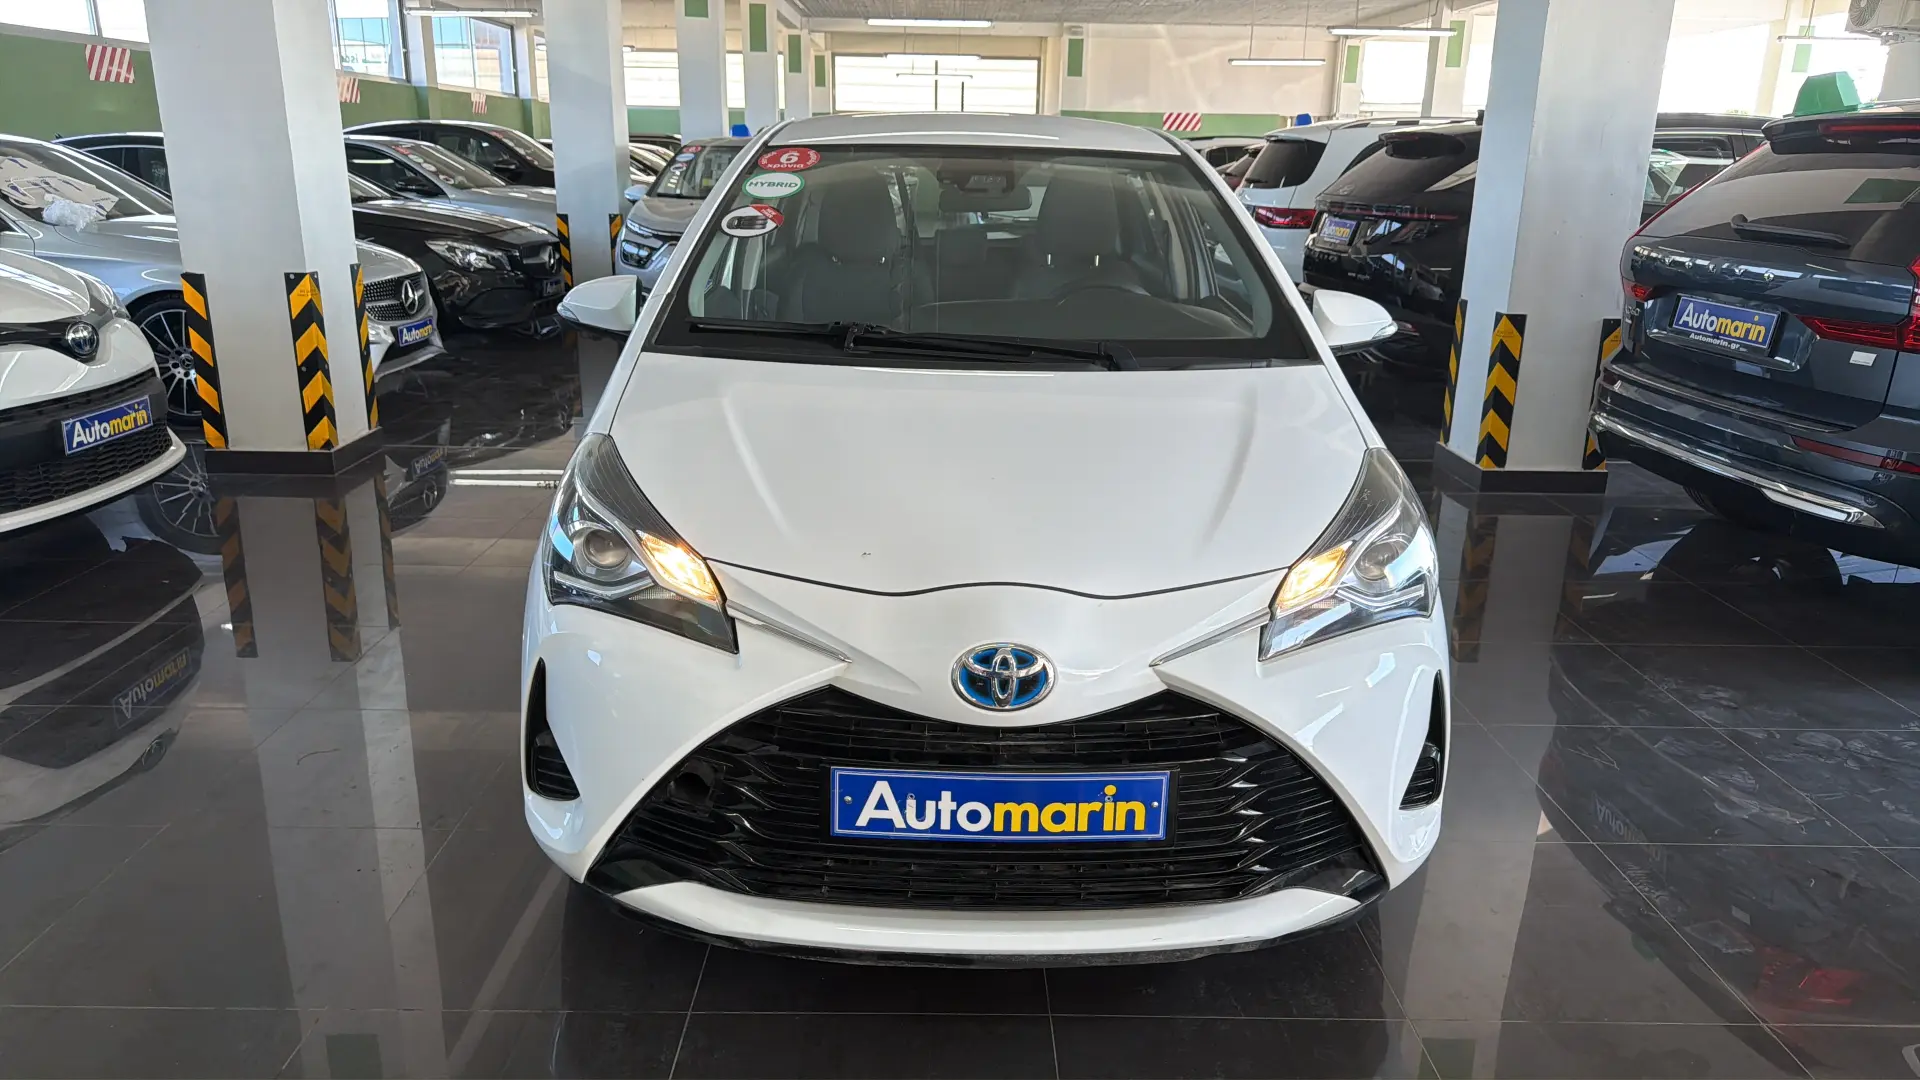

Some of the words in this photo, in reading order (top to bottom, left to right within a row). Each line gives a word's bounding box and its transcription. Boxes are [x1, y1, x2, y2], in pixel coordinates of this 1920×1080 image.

[779, 152, 800, 164] 6
[1678, 302, 1766, 343] Automarin
[1689, 332, 1741, 350] Automarin.gr
[72, 403, 149, 448] Automarin
[854, 780, 1147, 833] Automarin
